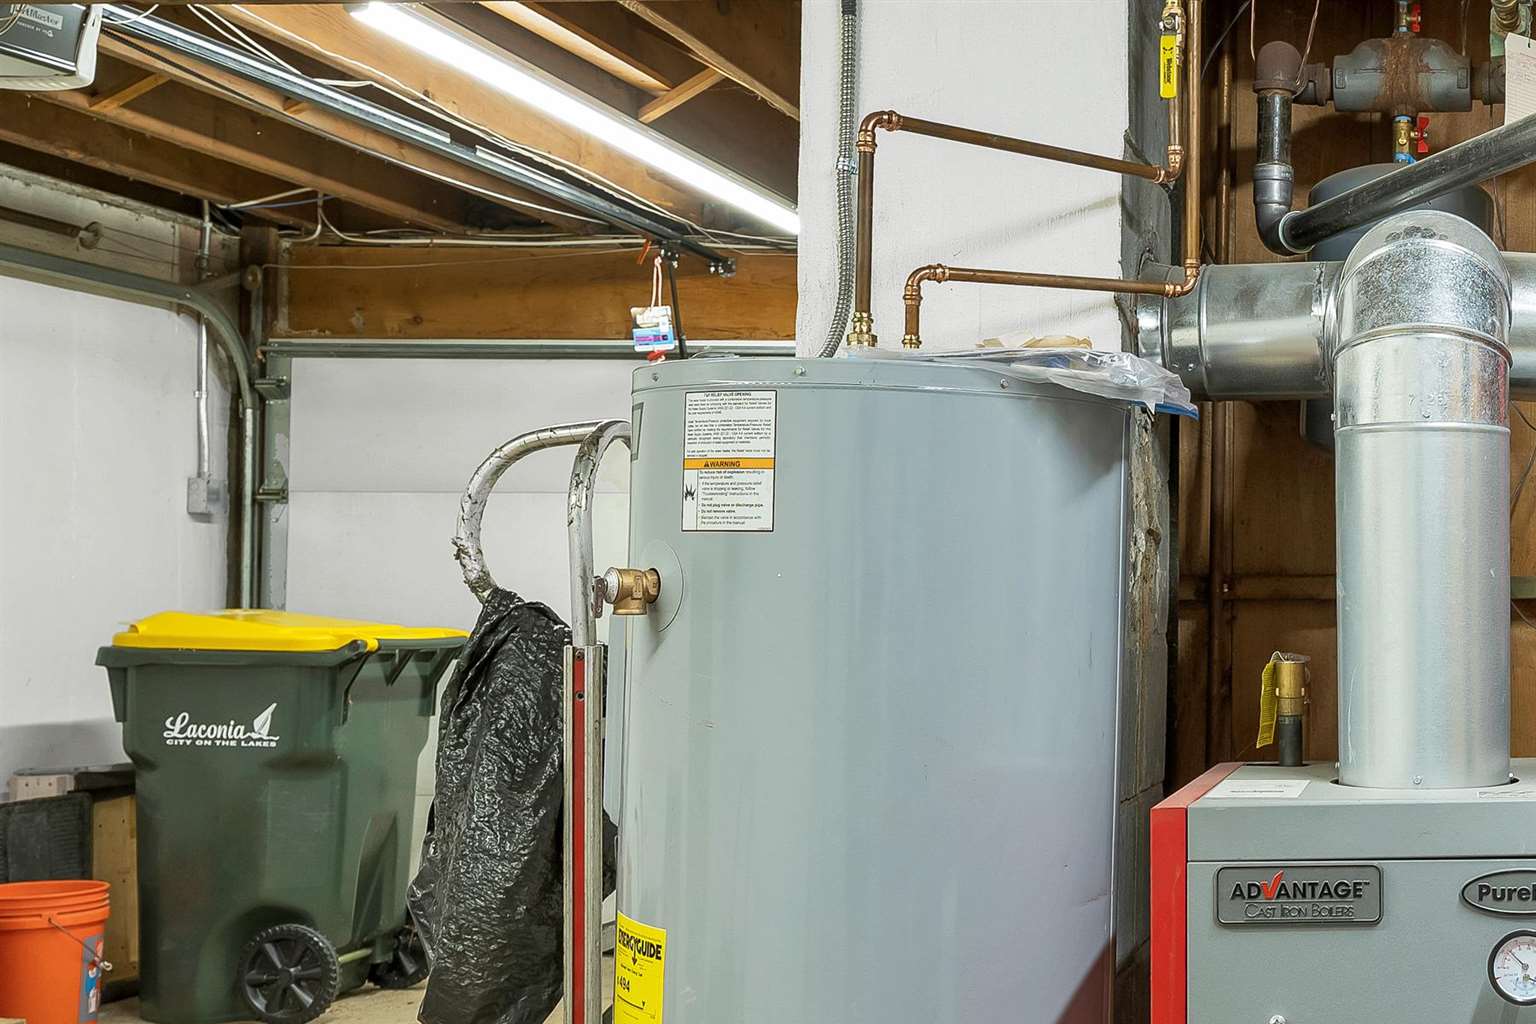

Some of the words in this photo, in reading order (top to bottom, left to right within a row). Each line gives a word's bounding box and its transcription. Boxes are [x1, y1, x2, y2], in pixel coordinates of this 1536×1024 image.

[709, 460, 741, 468] WARNING
[163, 711, 246, 739] Laconia
[1231, 869, 1364, 901] ADVANTAGE
